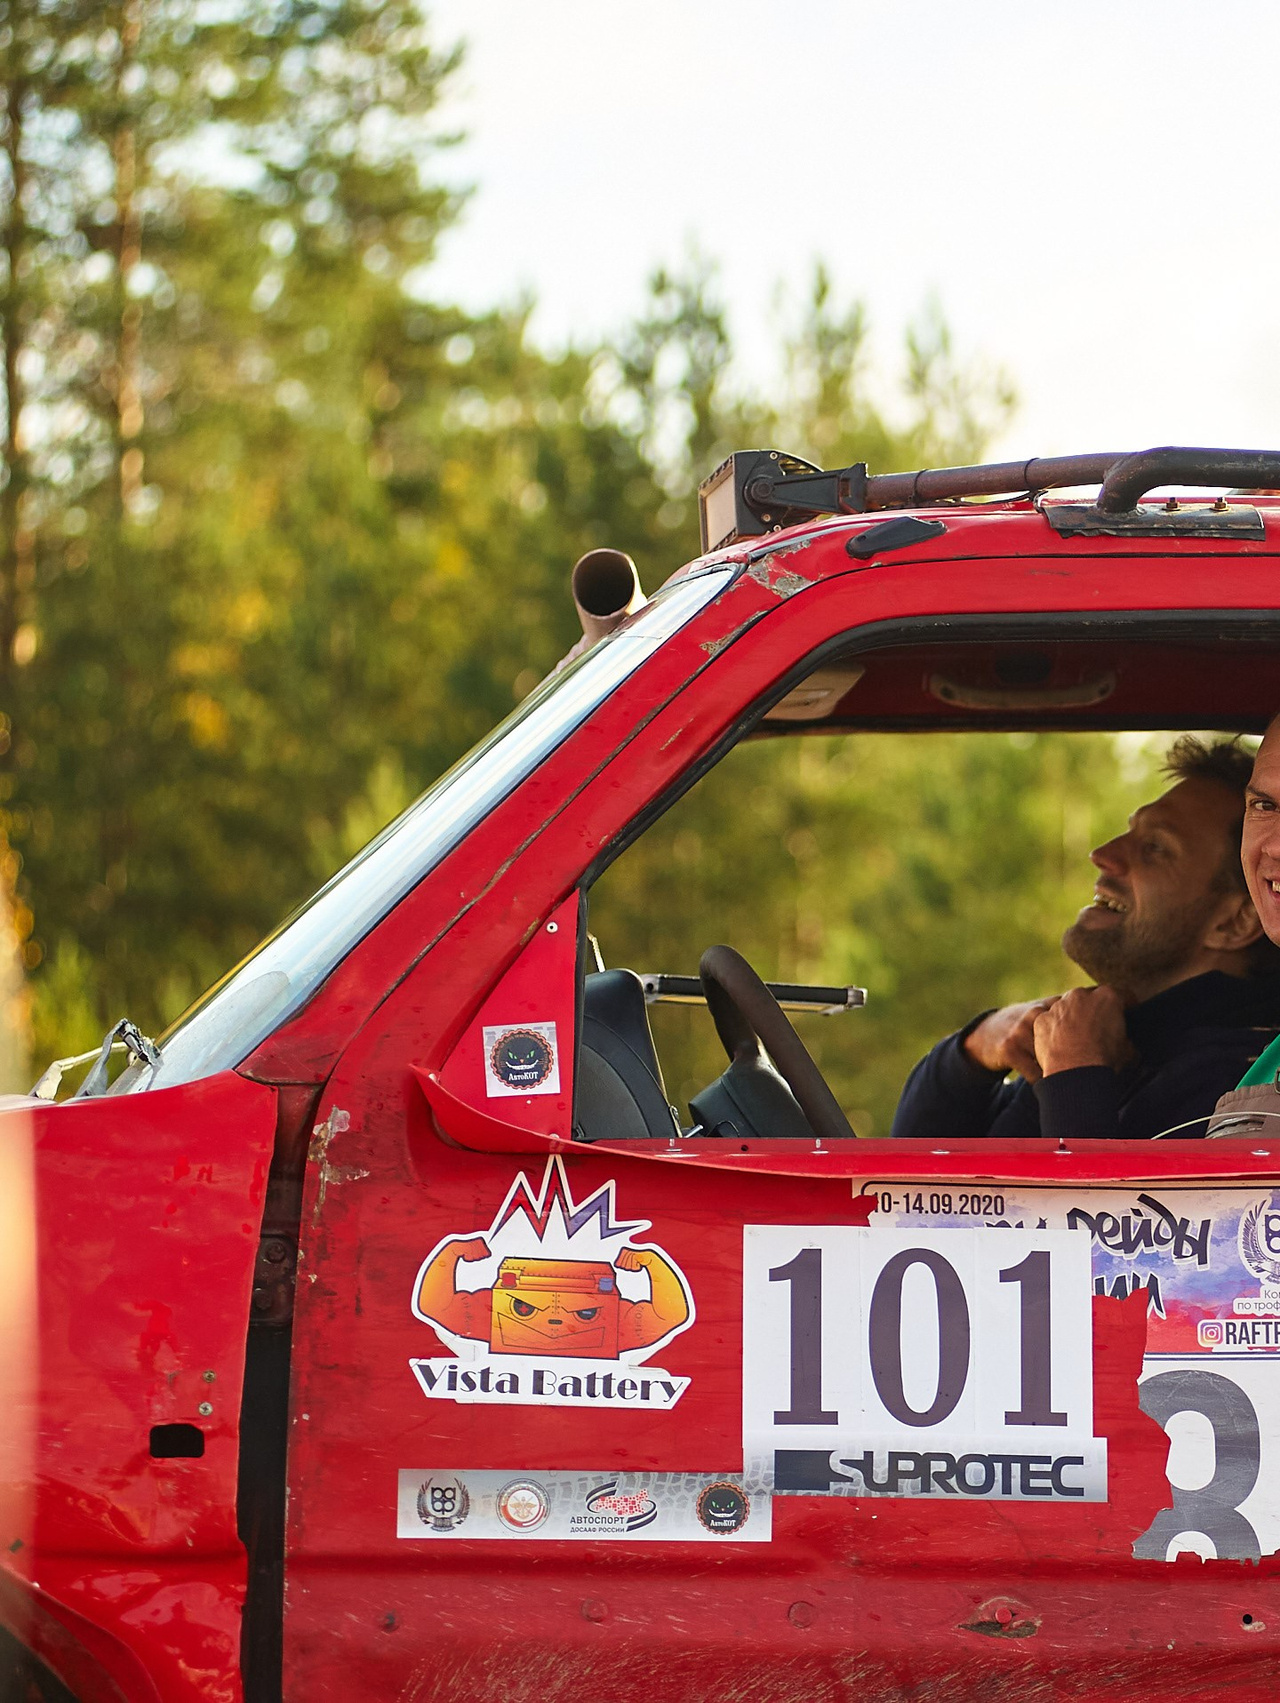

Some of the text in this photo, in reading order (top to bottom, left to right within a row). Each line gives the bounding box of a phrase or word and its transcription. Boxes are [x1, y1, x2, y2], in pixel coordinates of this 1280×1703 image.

[1237, 1302, 1251, 1310] по
[769, 1248, 1068, 1428] 101
[416, 1364, 684, 1403] Vista Battery
[826, 1450, 1085, 1497] SUPROTEC
[570, 1516, 625, 1525] АВТОСПОРТ
